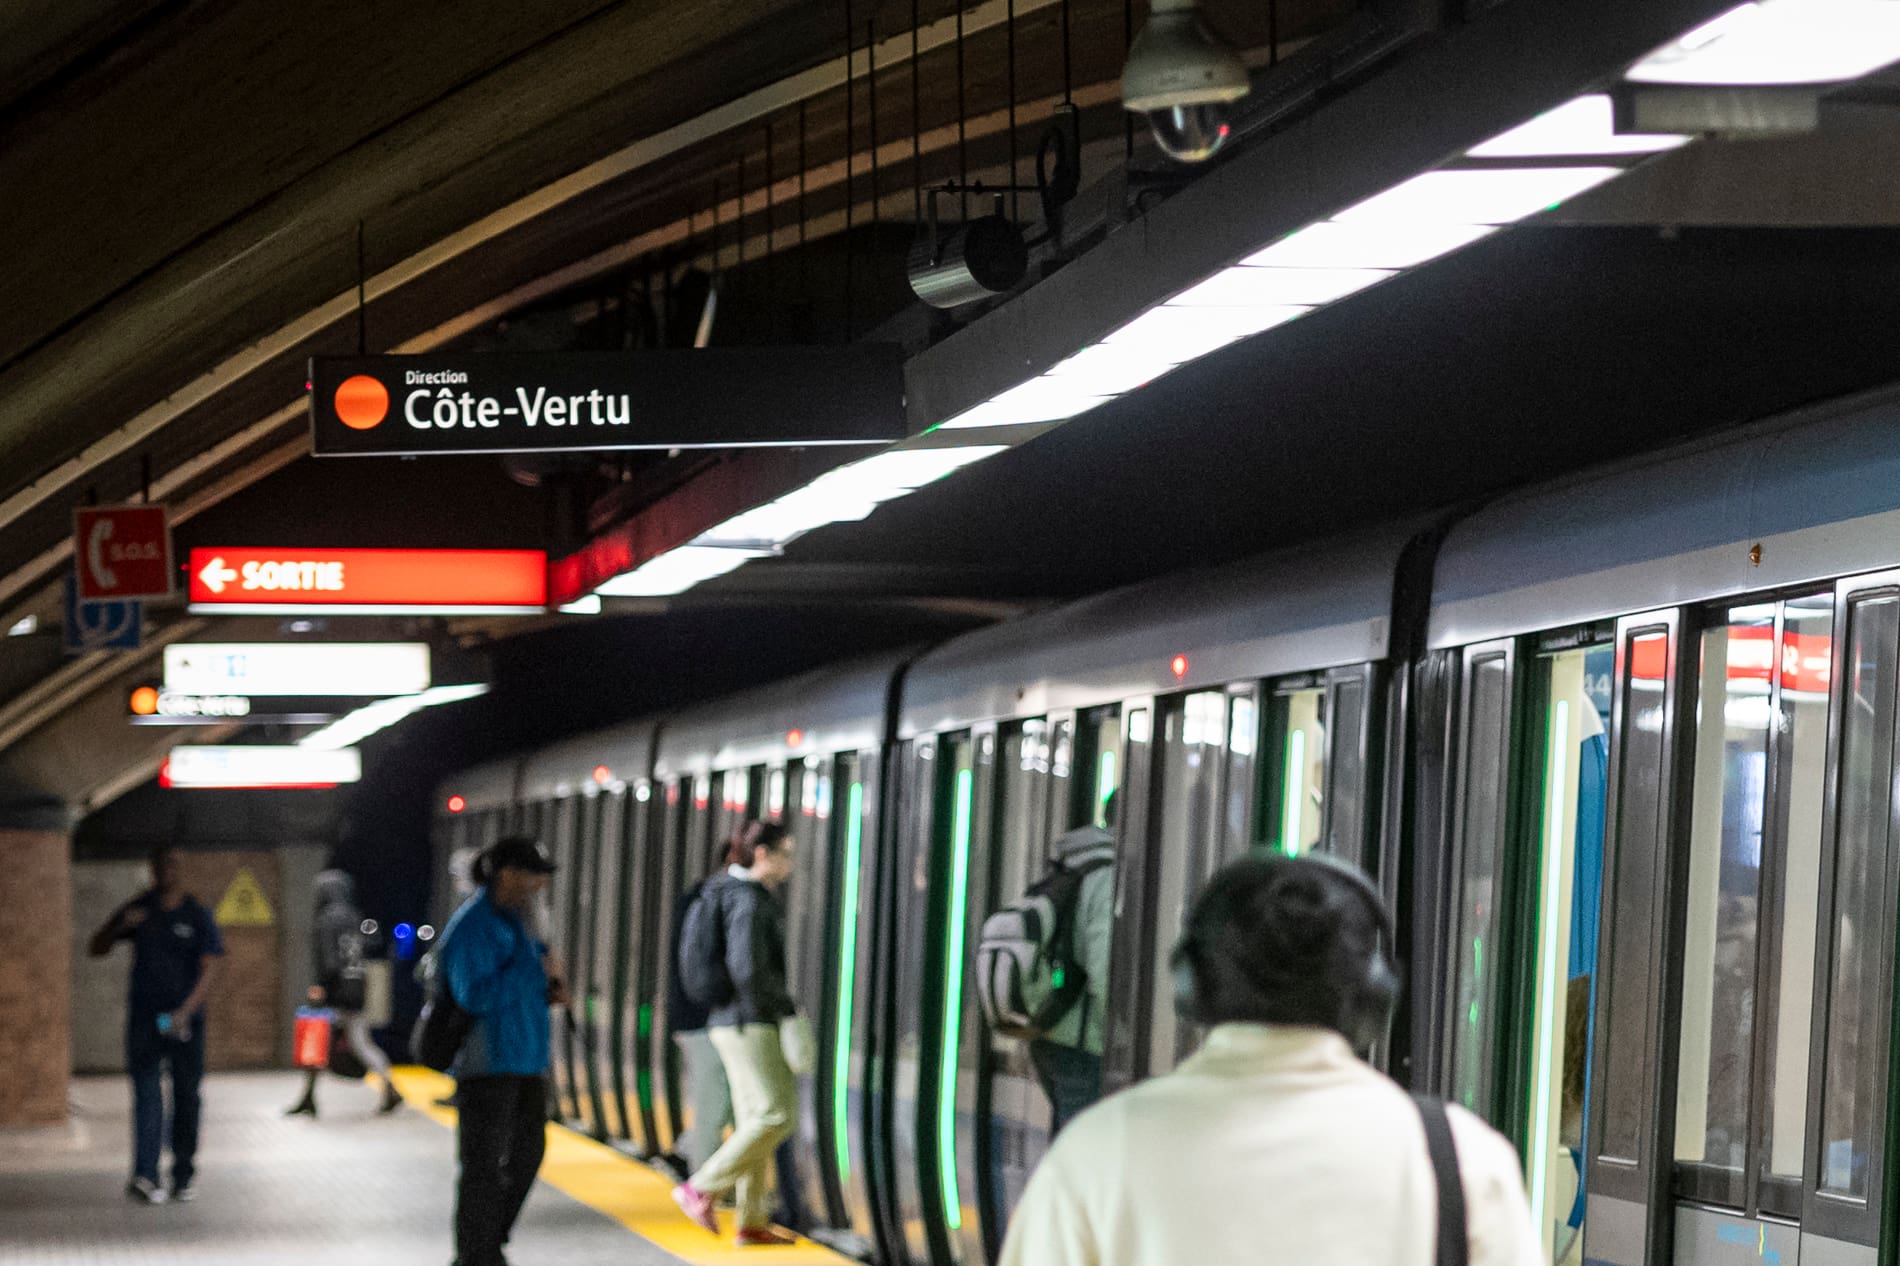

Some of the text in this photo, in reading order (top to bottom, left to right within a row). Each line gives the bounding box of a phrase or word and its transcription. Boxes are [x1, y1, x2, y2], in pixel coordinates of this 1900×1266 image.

[405, 370, 468, 385] Direction
[404, 386, 631, 429] Côte-Vertu
[241, 560, 345, 590] SORTIE
